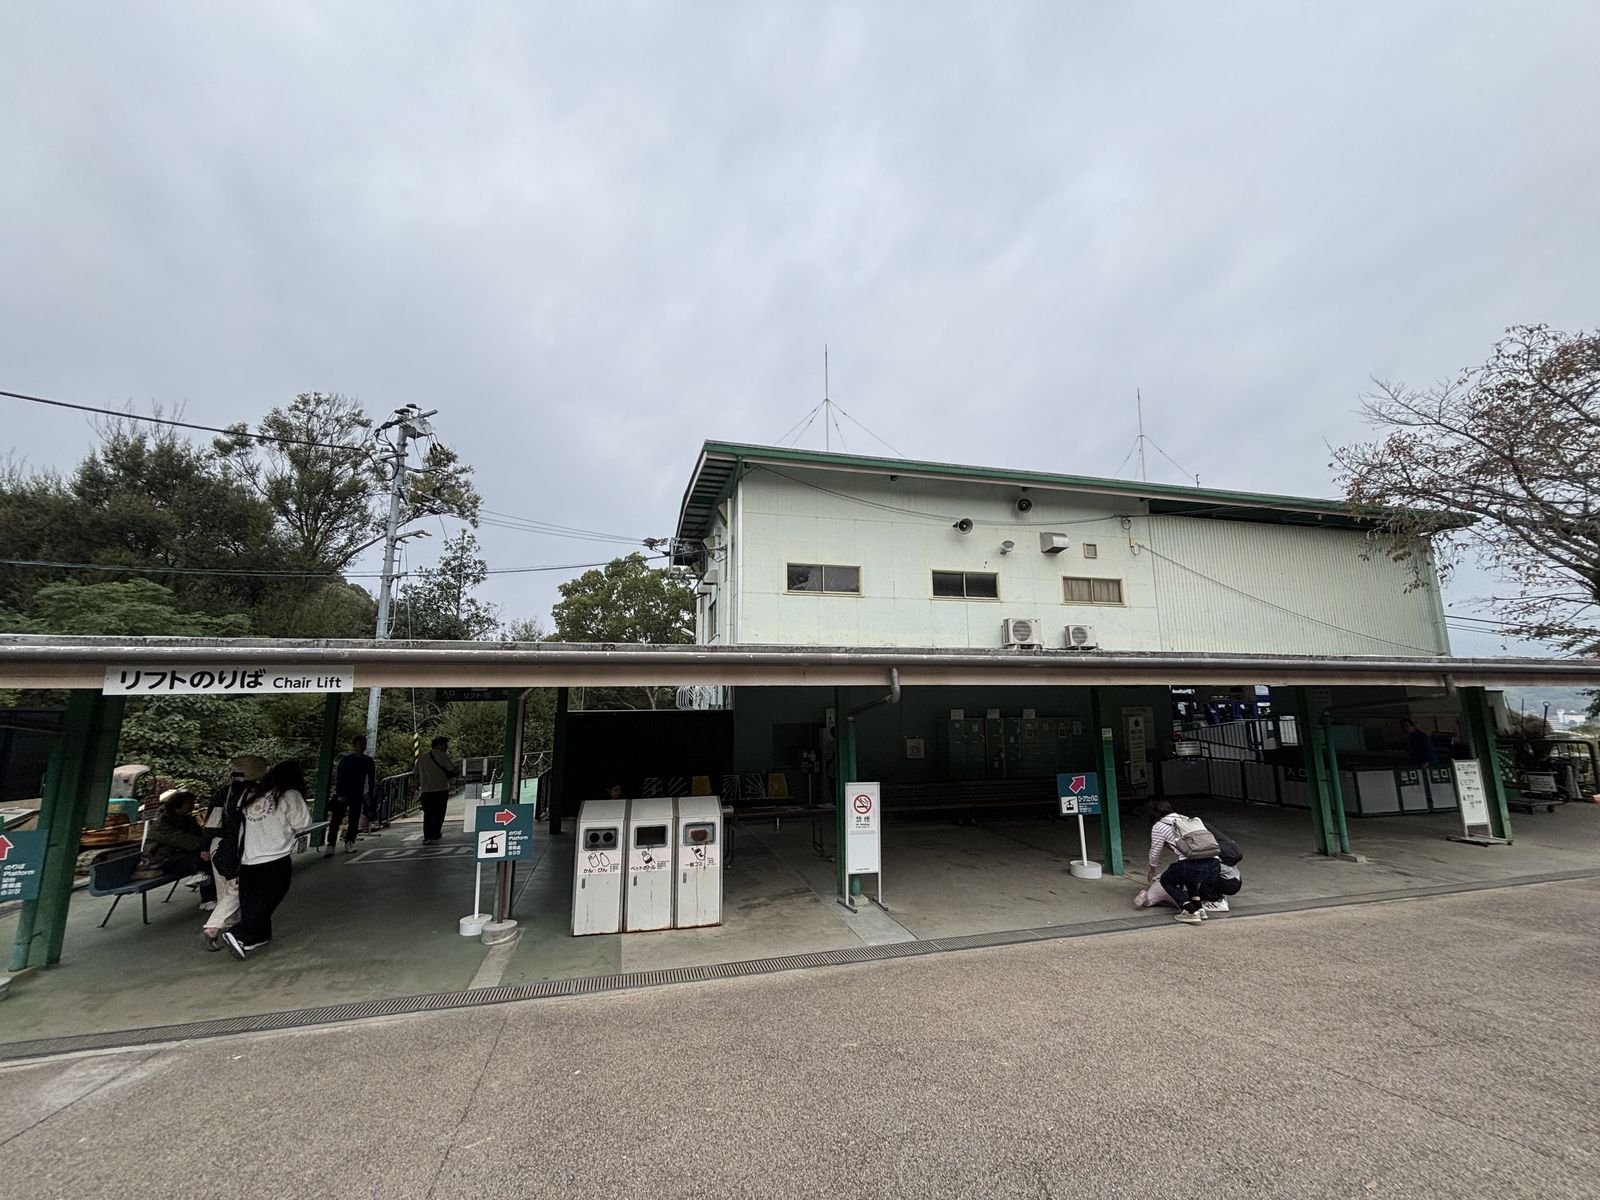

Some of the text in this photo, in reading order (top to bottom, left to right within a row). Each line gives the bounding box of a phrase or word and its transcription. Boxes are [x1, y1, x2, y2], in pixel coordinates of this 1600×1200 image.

[120, 669, 266, 690] リフトのりば
[273, 676, 342, 689] Chair Lift
